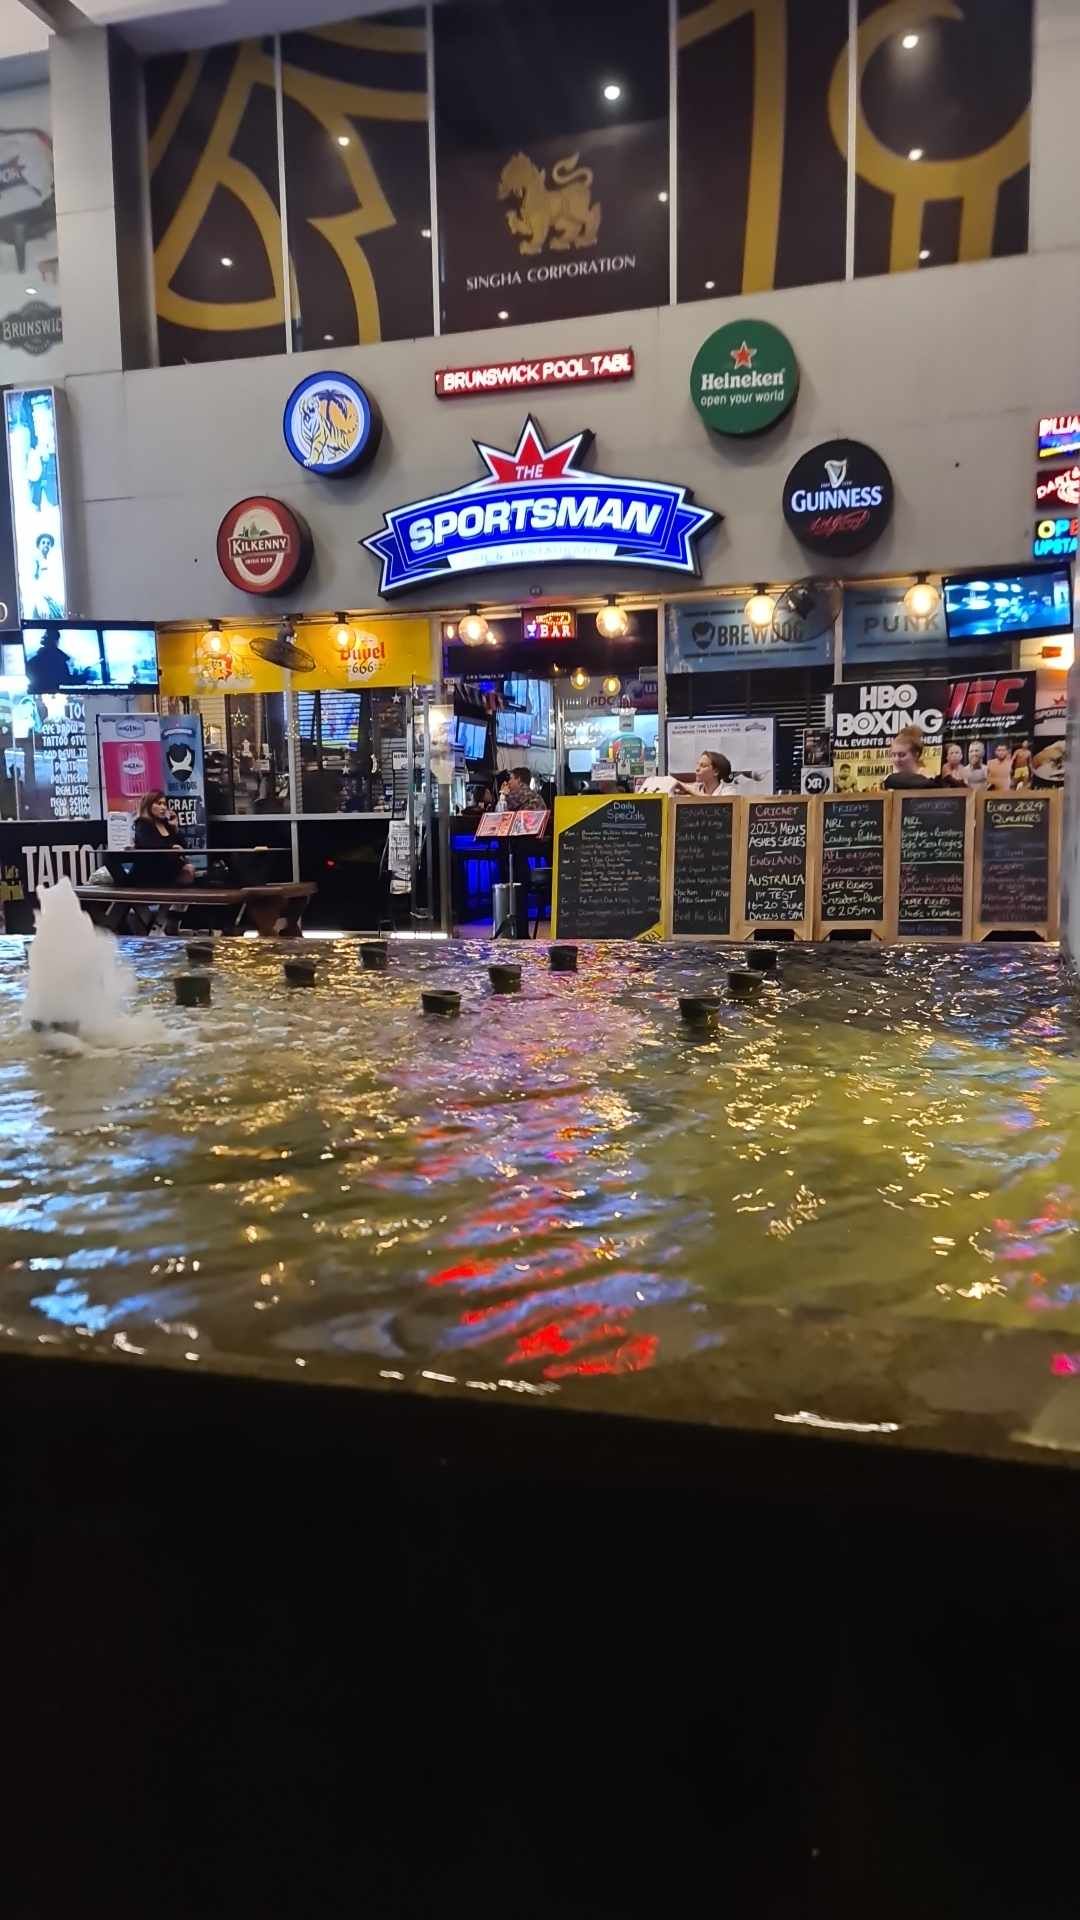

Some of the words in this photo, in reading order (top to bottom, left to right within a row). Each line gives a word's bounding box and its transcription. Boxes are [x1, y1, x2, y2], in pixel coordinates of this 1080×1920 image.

[466, 272, 522, 291] SINGHA
[526, 256, 636, 282] CORPORATION
[443, 363, 540, 391] BRUNSWICK
[542, 357, 589, 380] POOL
[701, 370, 784, 391] Heineken
[700, 395, 727, 408] open
[729, 392, 753, 407] your
[755, 389, 785, 402] world
[515, 464, 544, 480] THE
[791, 485, 883, 513] GUINNESS
[408, 496, 662, 553] SPORTSMAN
[232, 538, 287, 555] KILKENNY
[540, 624, 570, 638] BAR
[863, 614, 940, 635] PUNK
[352, 660, 374, 675] 666
[860, 684, 918, 711] HBO
[945, 679, 1024, 716] UFC
[836, 709, 943, 737] BOXING
[833, 739, 849, 747] ALL
[850, 737, 883, 747] EVENTS
[168, 799, 197, 811] CRAFT
[755, 805, 800, 817] CRICKET
[178, 811, 197, 827] EER
[606, 809, 646, 822] Specials
[751, 822, 778, 835] 2023
[750, 855, 802, 867] ENGLAND
[748, 873, 805, 887] AUSTRALIA
[768, 889, 797, 901] TEST
